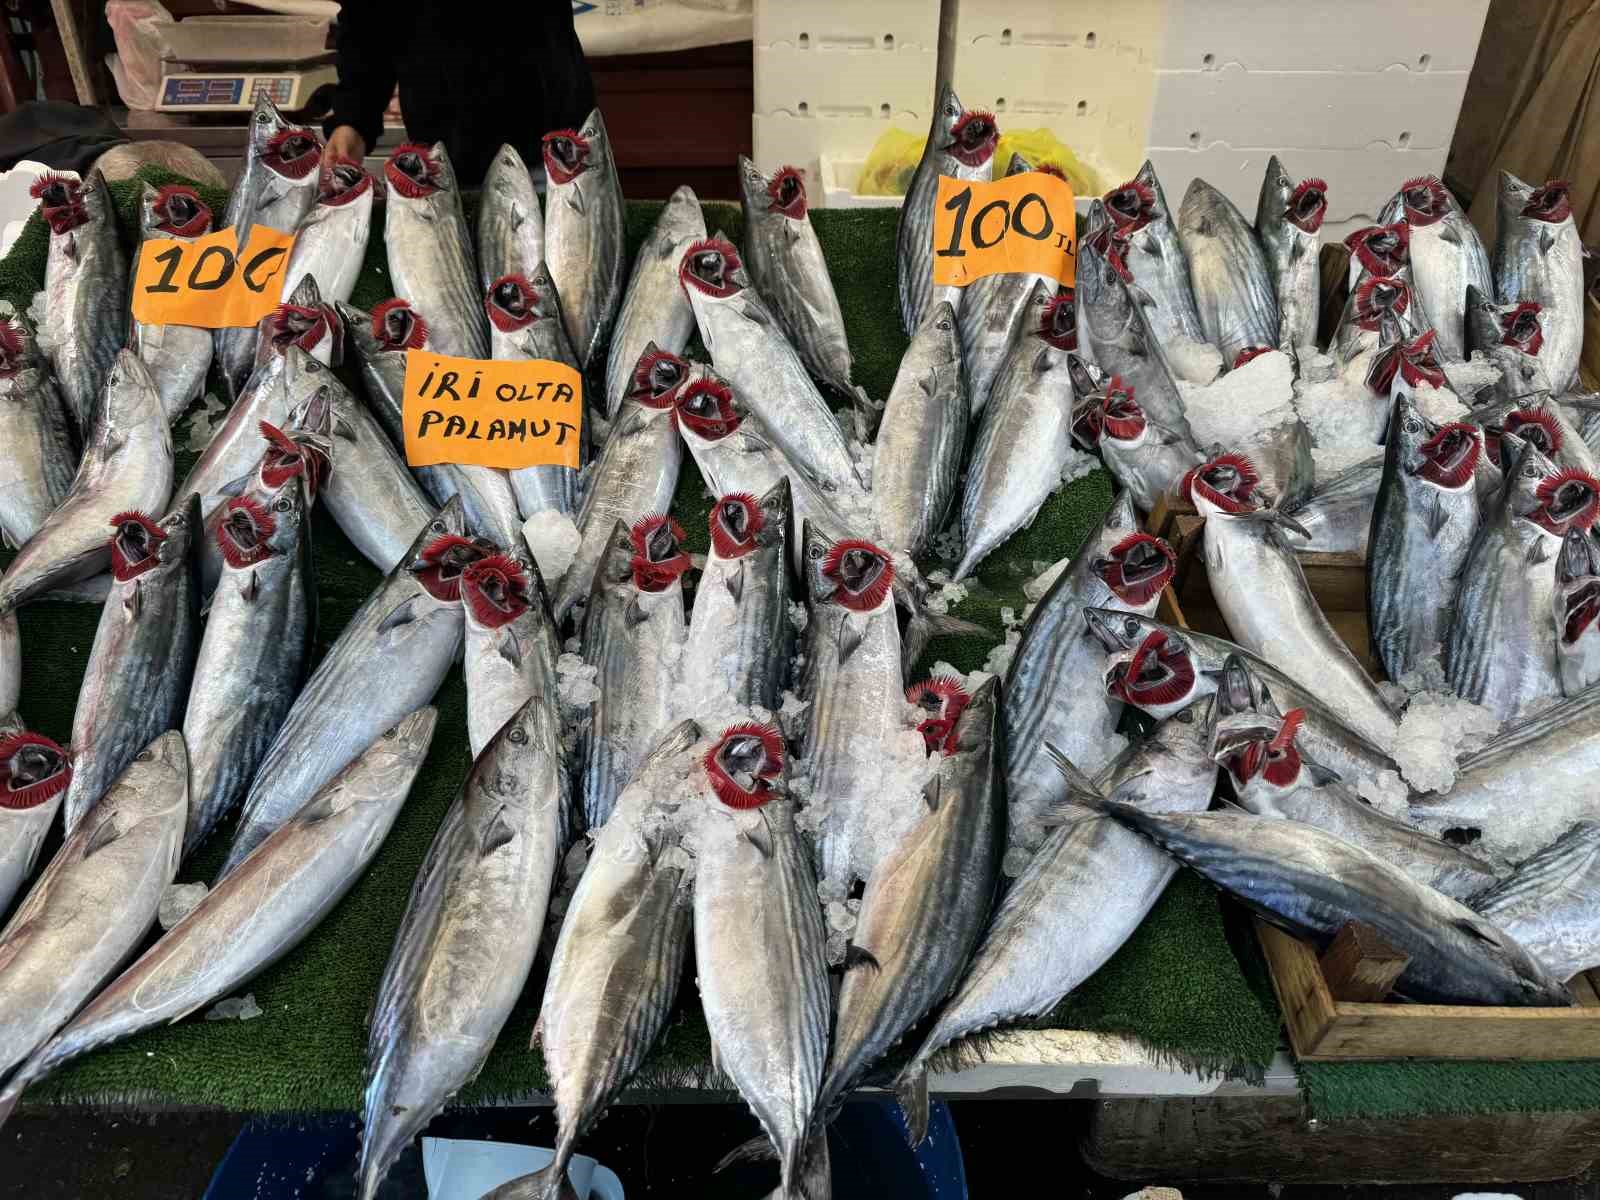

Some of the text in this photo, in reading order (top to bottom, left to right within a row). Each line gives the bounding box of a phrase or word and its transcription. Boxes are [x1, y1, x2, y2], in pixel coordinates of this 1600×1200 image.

[936, 186, 1053, 257] 100
[495, 382, 573, 403] OLTA
[418, 410, 577, 445] PALAMUT
